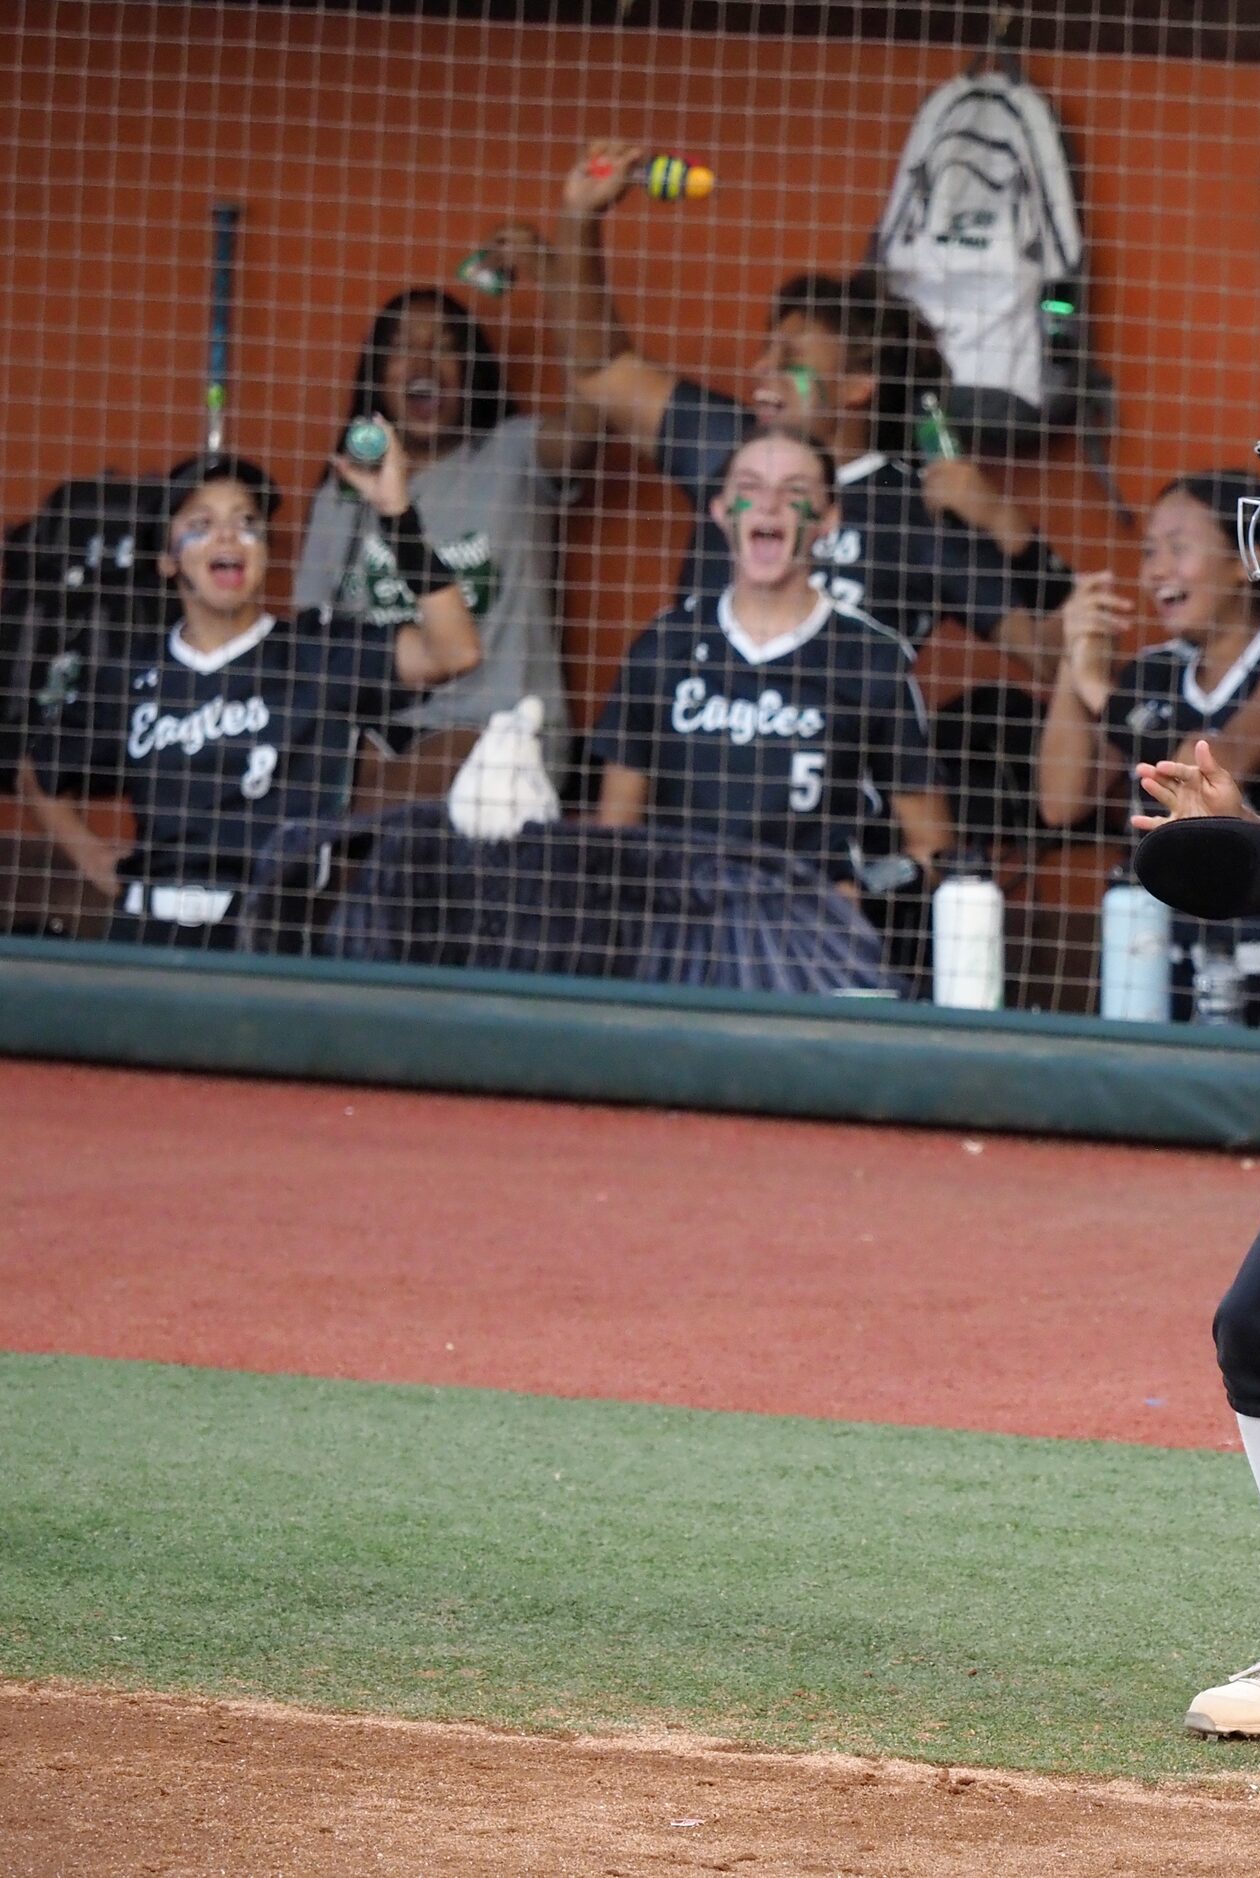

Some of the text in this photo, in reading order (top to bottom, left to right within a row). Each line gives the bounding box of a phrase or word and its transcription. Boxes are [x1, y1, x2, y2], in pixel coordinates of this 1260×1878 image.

[127, 694, 270, 760] Eagles
[670, 676, 825, 745] Eagles
[240, 742, 279, 800] 8
[789, 750, 827, 813] 5
